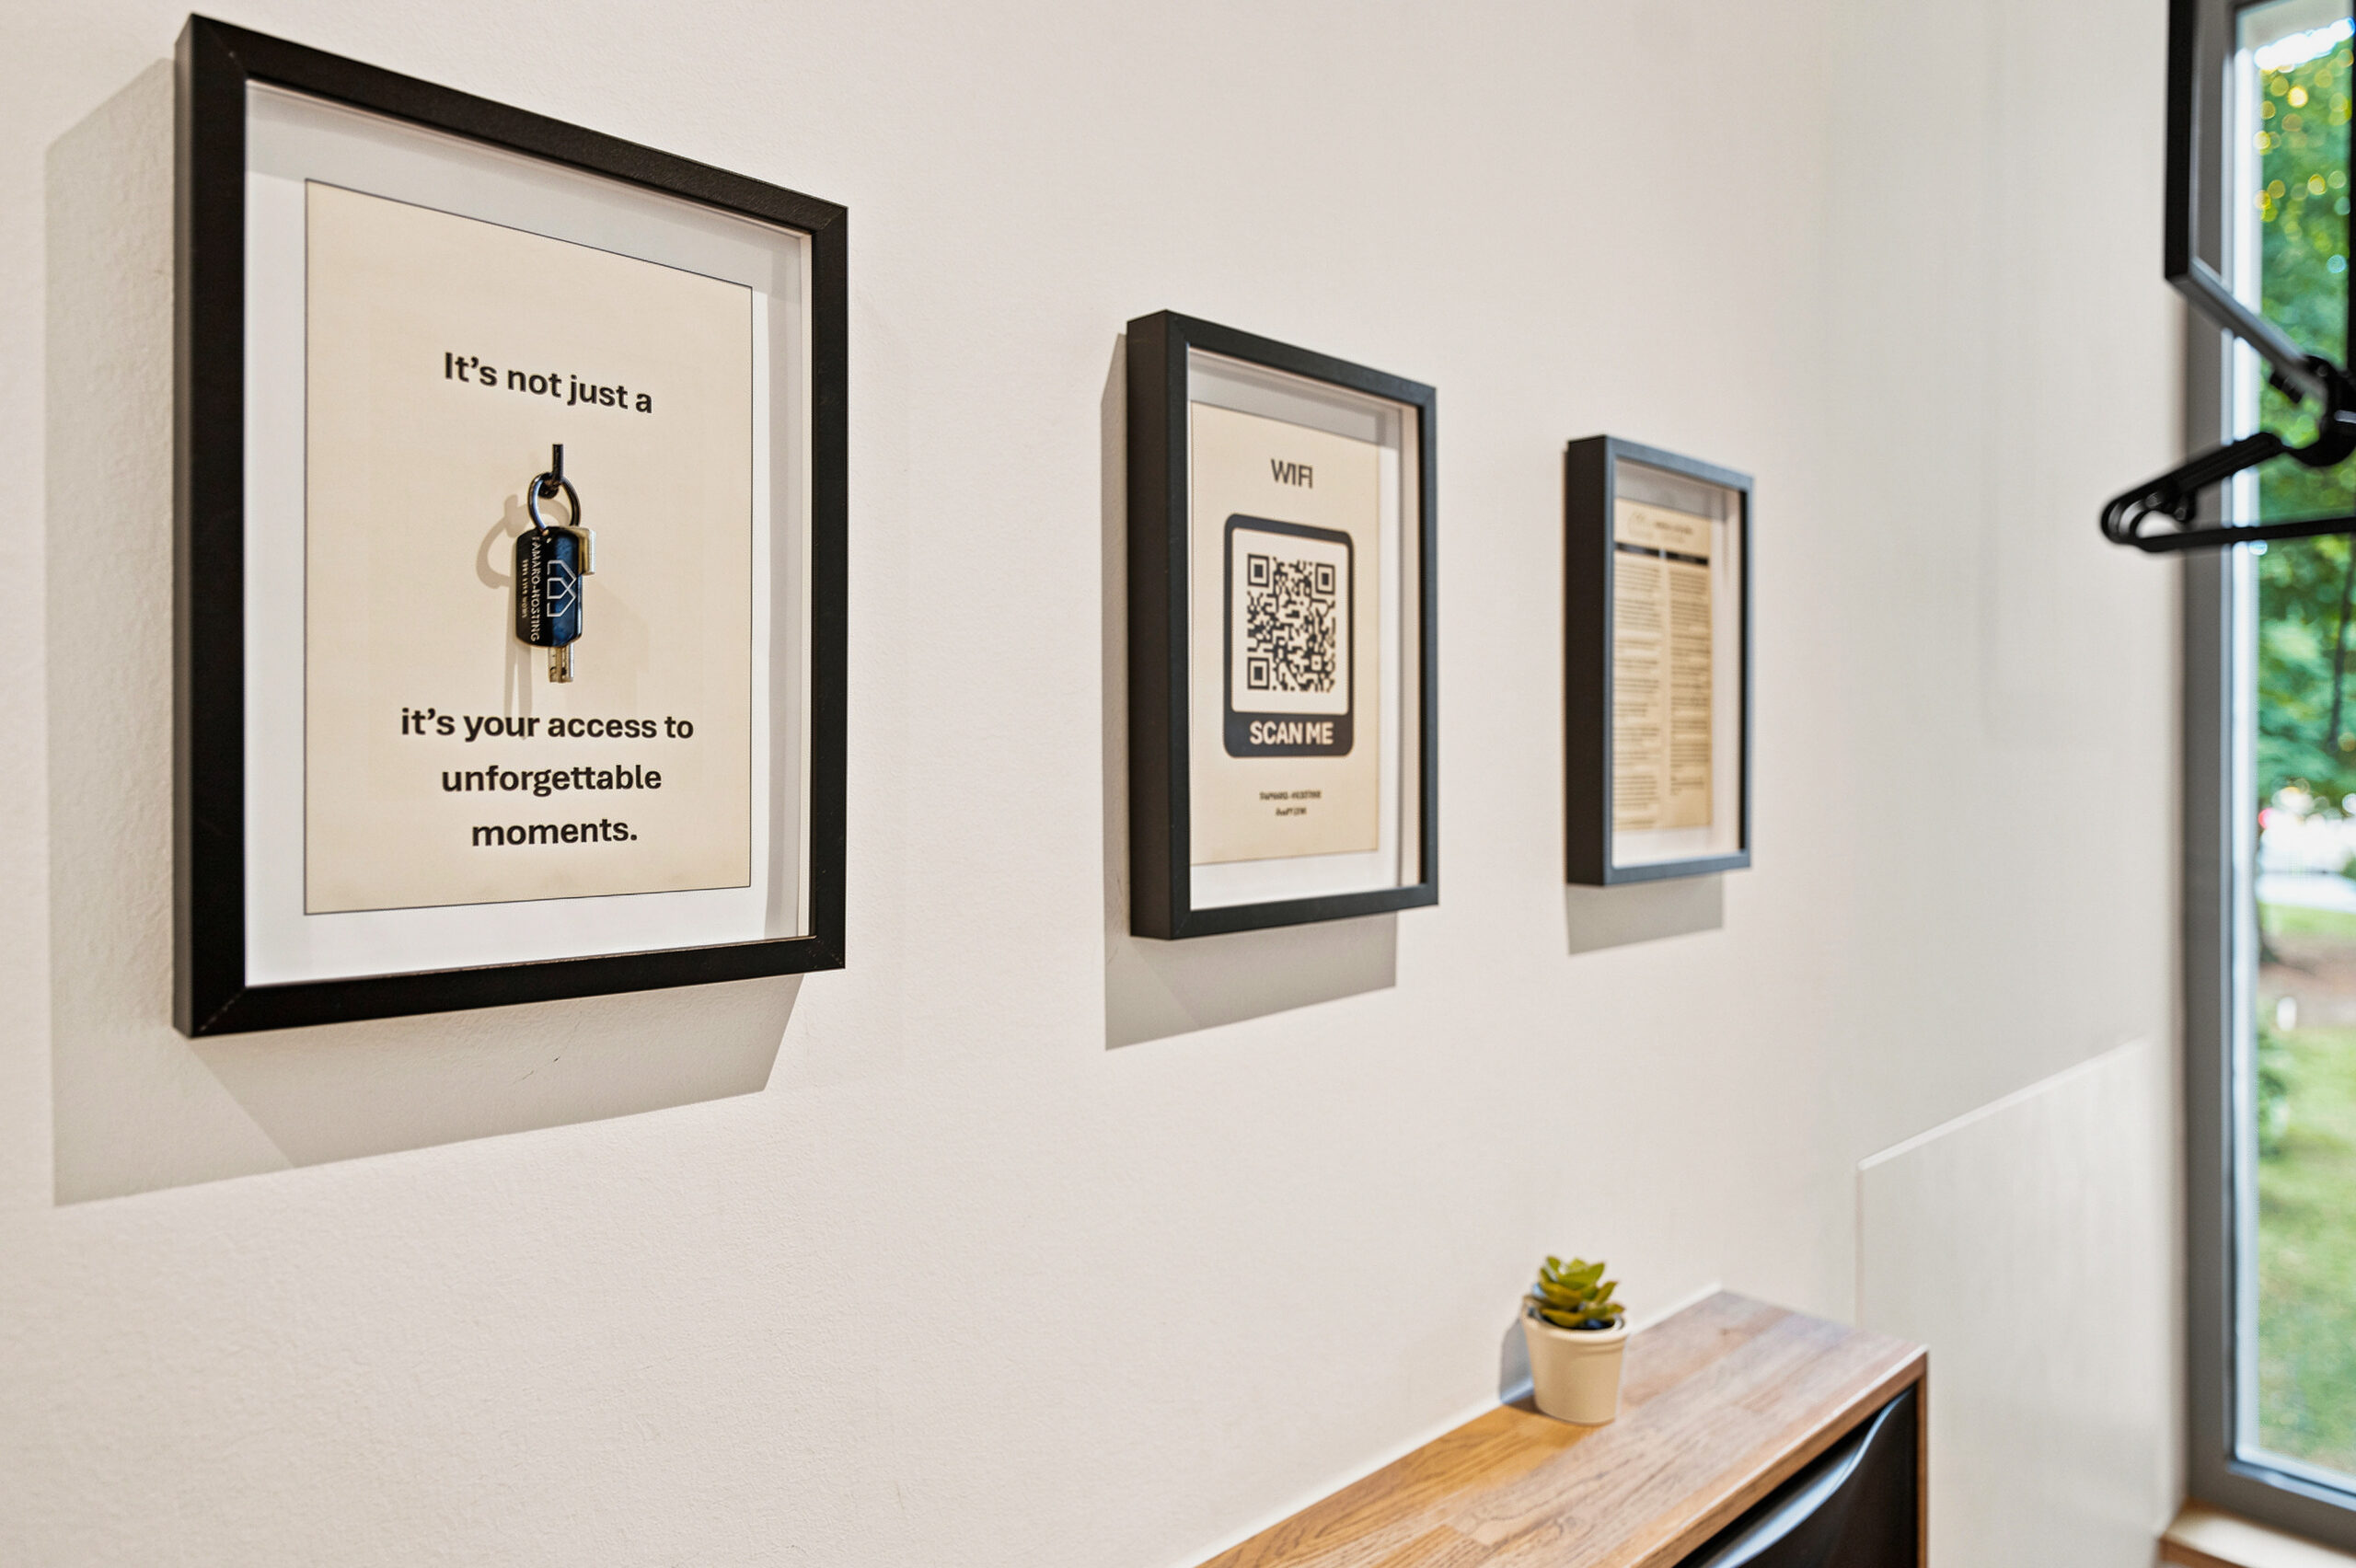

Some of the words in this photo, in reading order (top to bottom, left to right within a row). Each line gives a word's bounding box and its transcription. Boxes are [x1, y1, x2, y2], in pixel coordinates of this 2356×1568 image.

[444, 351, 498, 386] It’s
[507, 369, 562, 398] not
[566, 373, 629, 409] just
[635, 392, 653, 414] a
[1270, 458, 1313, 489] WIFI
[401, 707, 456, 736] it’s
[463, 715, 540, 743] your
[548, 717, 657, 739] access
[664, 715, 694, 739] to
[1250, 721, 1303, 745] SCAN
[1305, 721, 1334, 745] ME
[442, 763, 662, 798] unforgettable
[471, 817, 638, 847] moments.
